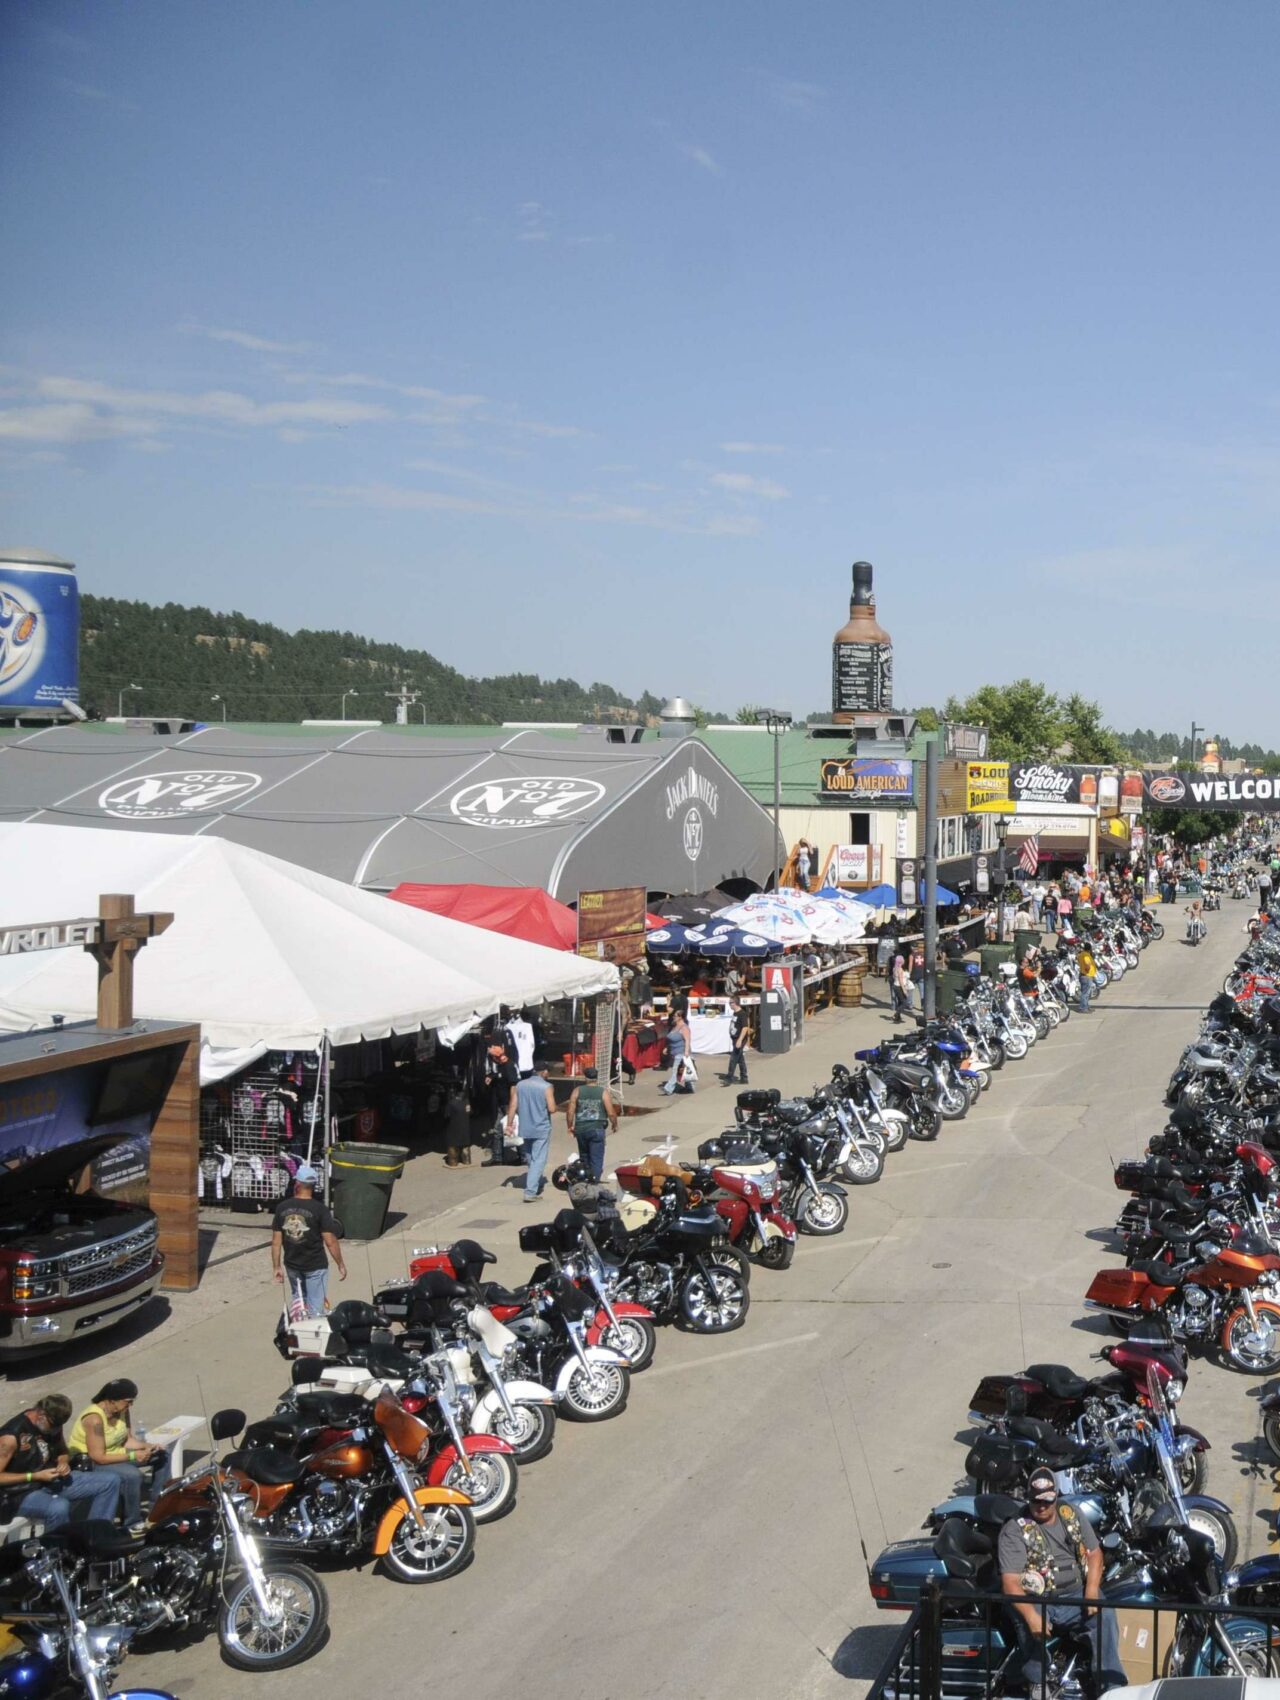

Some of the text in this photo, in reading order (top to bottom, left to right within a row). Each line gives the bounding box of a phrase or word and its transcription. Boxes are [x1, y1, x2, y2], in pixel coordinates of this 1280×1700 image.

[1038, 764, 1055, 777] Ole
[184, 774, 237, 783] OLD
[521, 780, 576, 790] OLD
[827, 774, 909, 791] LOUD AMERICAN
[1014, 766, 1073, 795] Smoky
[666, 775, 688, 819] JACK
